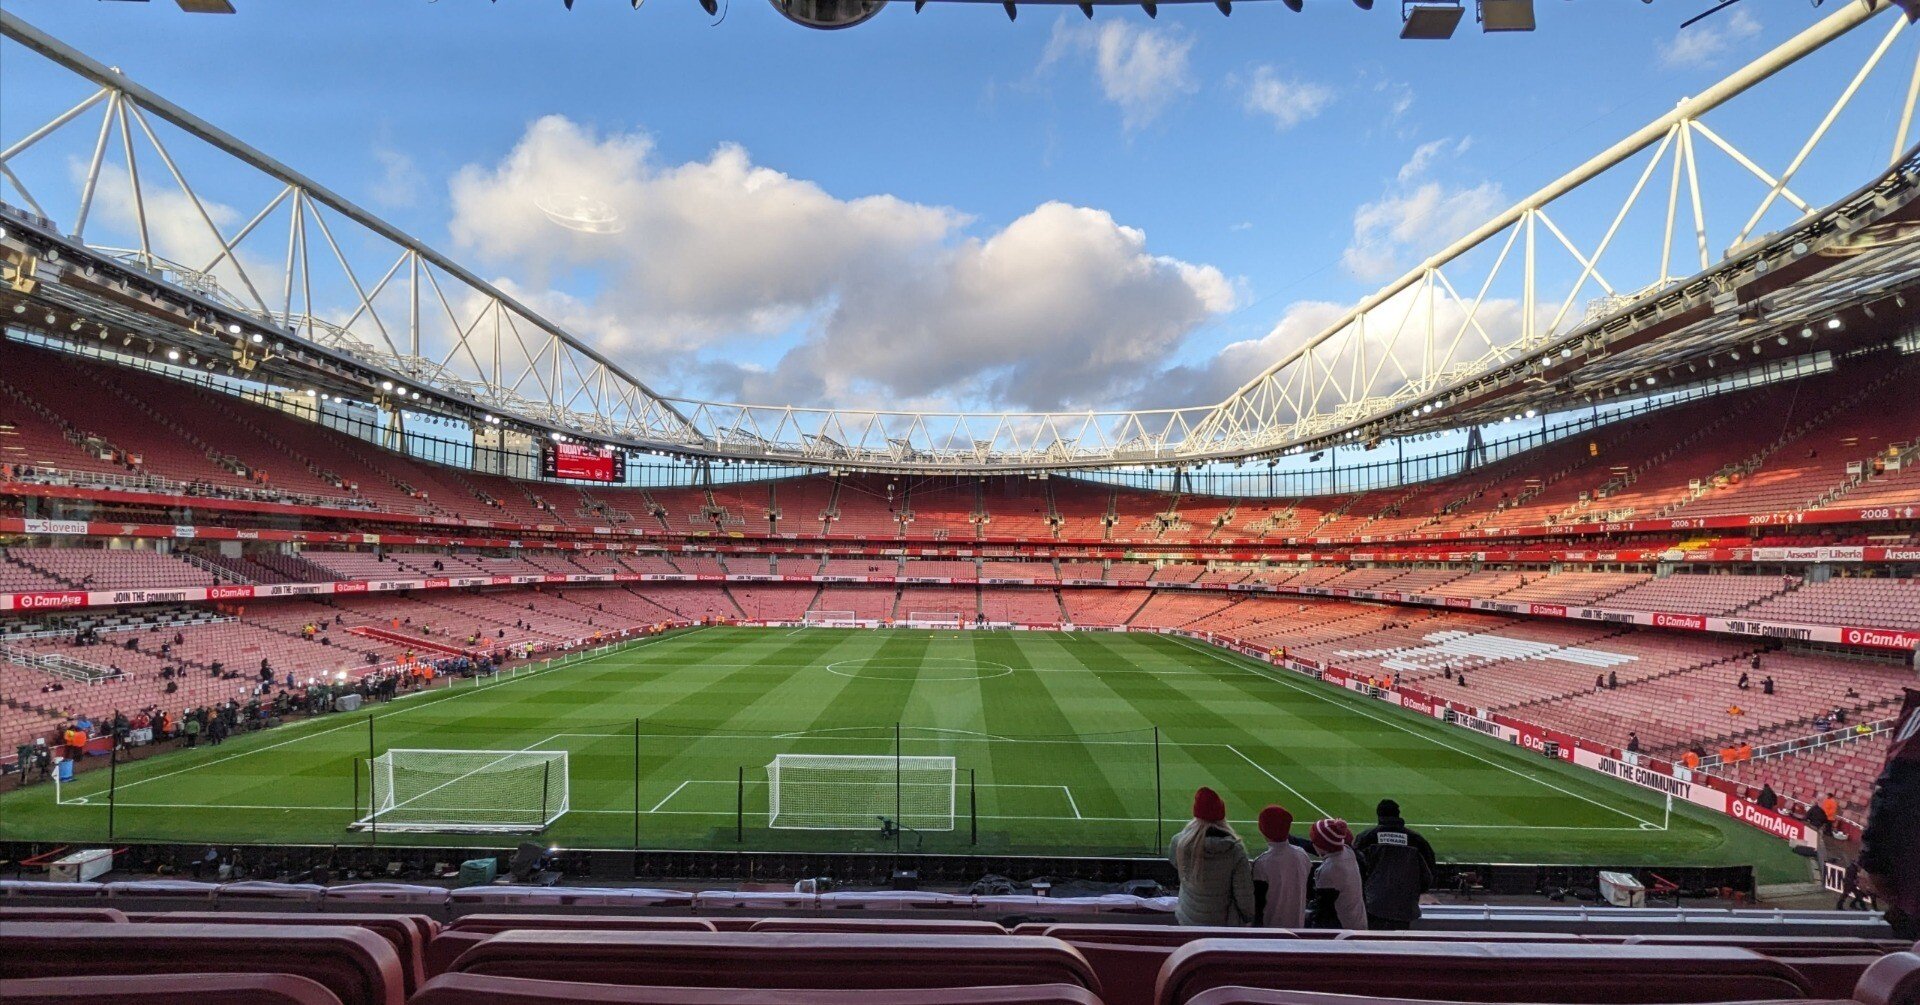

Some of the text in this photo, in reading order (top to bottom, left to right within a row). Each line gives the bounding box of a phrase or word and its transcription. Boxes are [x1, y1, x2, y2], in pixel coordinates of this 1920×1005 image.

[1861, 508, 1889, 519] 2008
[1671, 520, 1689, 528] 2006
[1749, 515, 1770, 524] 2007
[41, 521, 86, 533] Slovenia
[236, 530, 259, 539] Arsenal
[1596, 552, 1617, 560] Arsenal
[1787, 550, 1818, 558] Arsenal
[1829, 549, 1862, 559] Liberia
[343, 583, 365, 592] ComAve
[113, 592, 130, 602] JOIN
[132, 592, 145, 601] THE
[219, 588, 251, 598] ComAve
[1665, 616, 1701, 628] ComAve
[1747, 622, 1760, 634] THE
[1762, 626, 1812, 640] COMMUNITY
[1408, 699, 1432, 714] ComAve
[1532, 737, 1569, 758] Cove
[1598, 757, 1691, 799] JOIN THE COMMUNITY
[1745, 805, 1799, 840] ComAve
